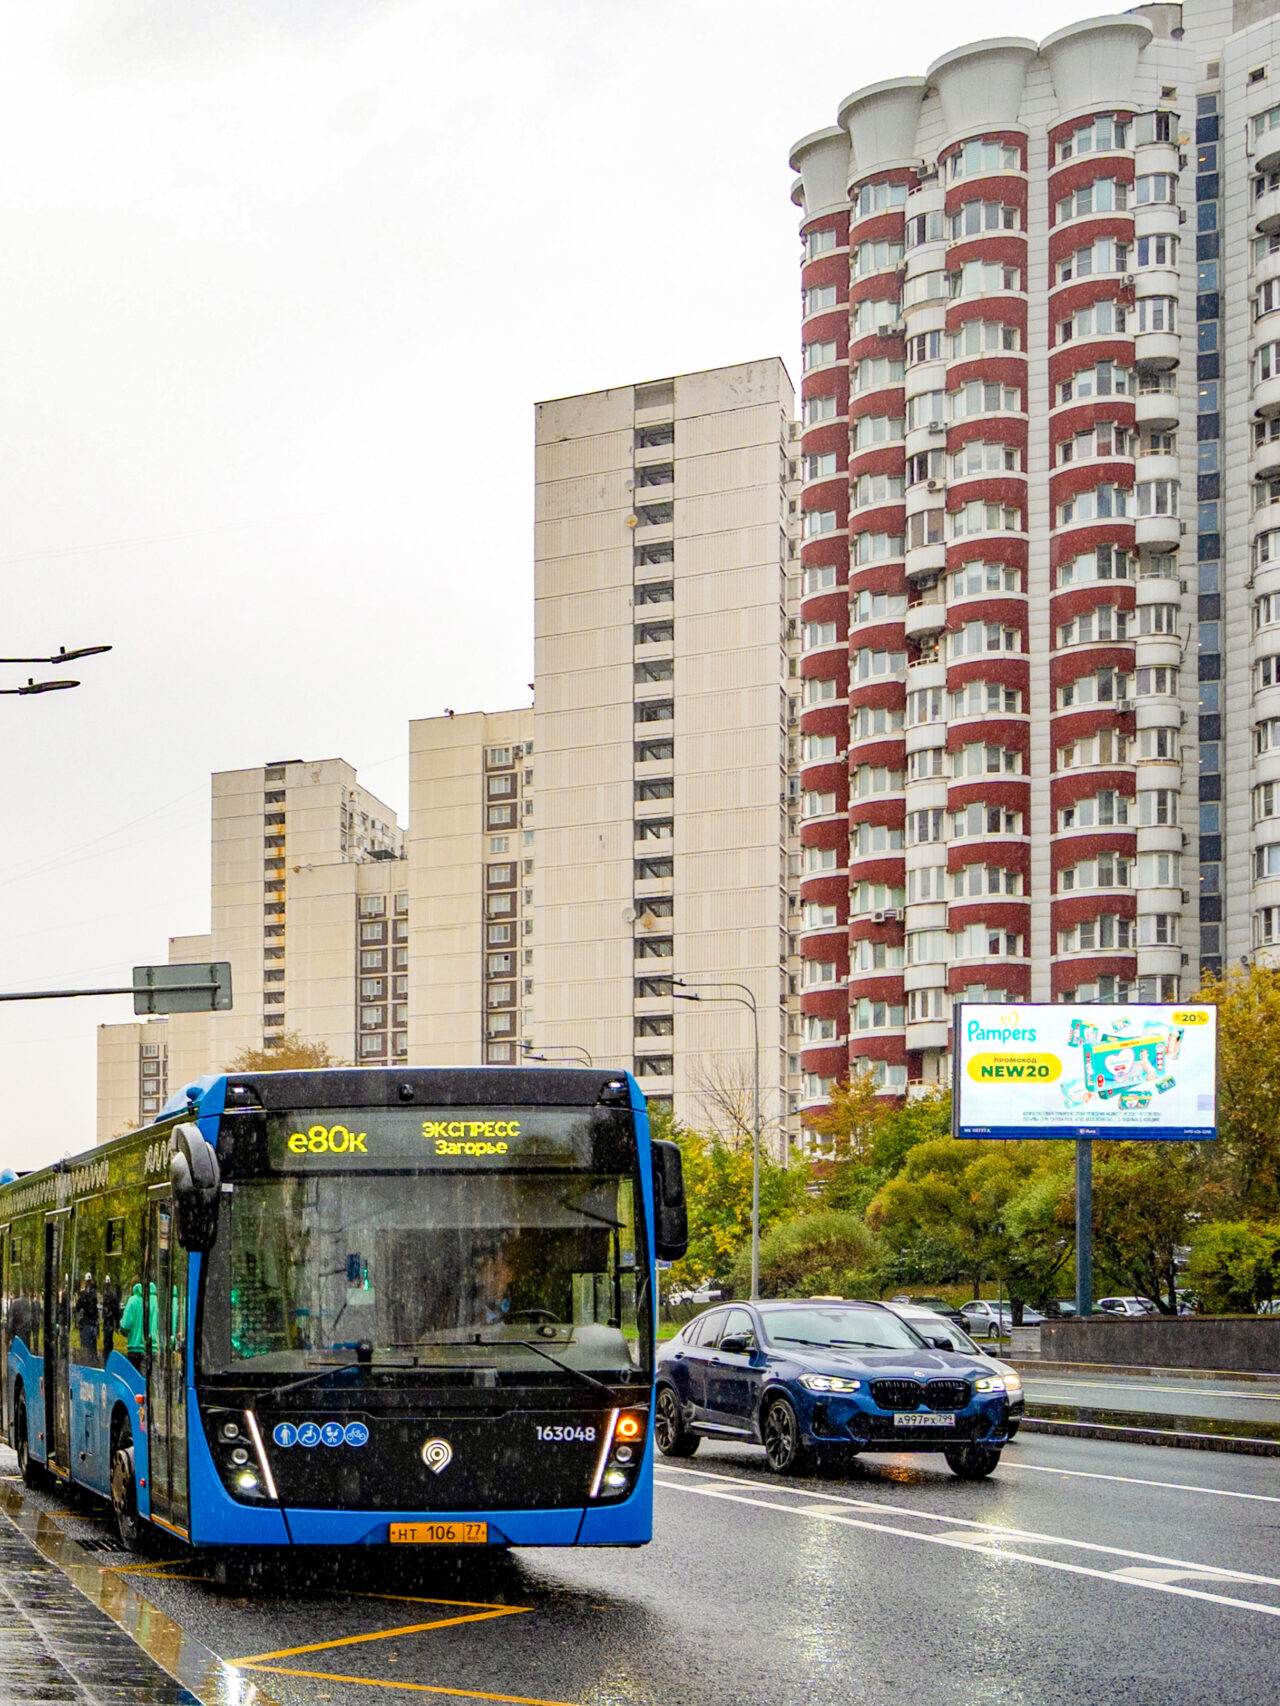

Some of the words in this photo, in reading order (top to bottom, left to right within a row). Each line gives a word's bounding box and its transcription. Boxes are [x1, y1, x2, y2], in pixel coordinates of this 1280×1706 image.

[968, 1020, 1036, 1044] Pampers
[981, 1065, 1050, 1077] NEW20
[422, 1121, 521, 1138] ЭКСПРЕСС
[288, 1125, 368, 1153] е80к
[435, 1139, 509, 1156] Загорье
[535, 1426, 596, 1441] 163048
[398, 1529, 417, 1541] НТ
[426, 1525, 456, 1540] 106
[466, 1525, 481, 1535] 77
